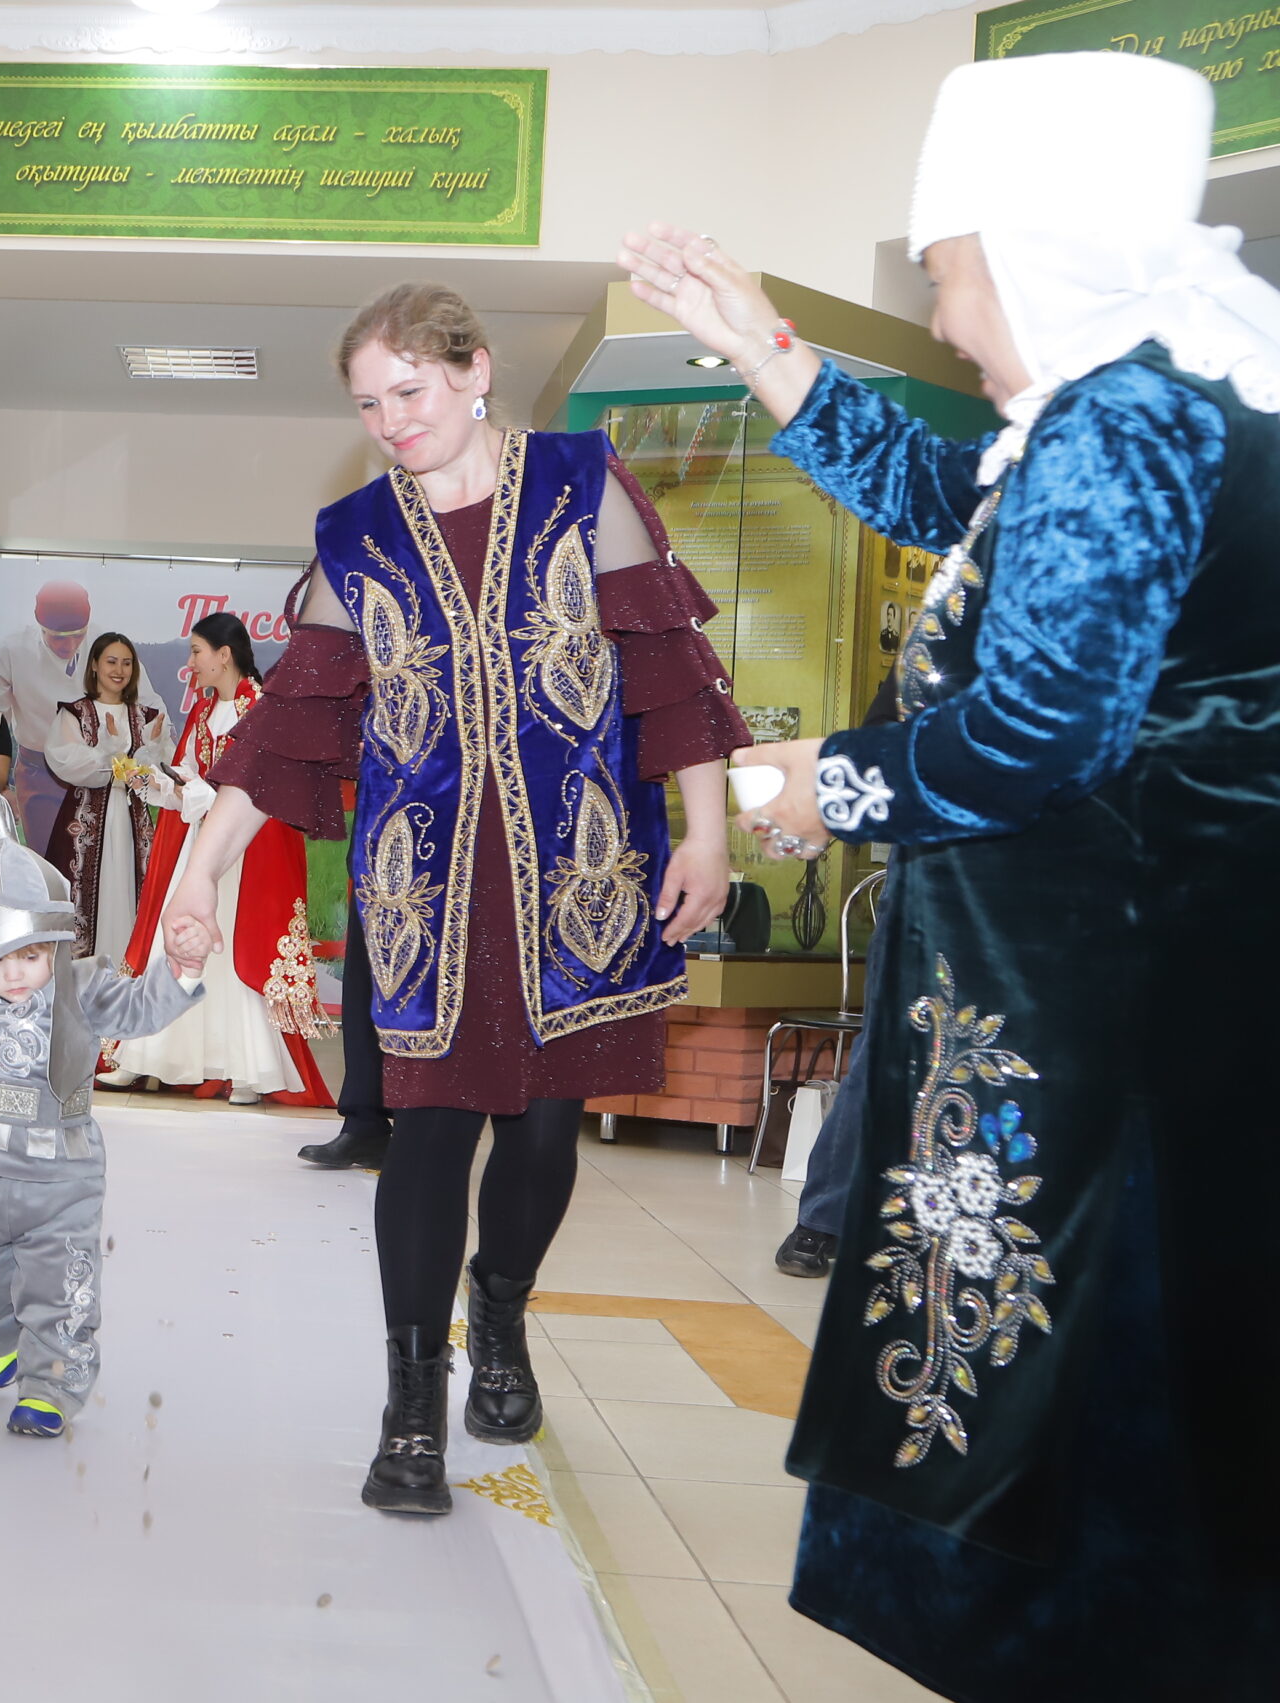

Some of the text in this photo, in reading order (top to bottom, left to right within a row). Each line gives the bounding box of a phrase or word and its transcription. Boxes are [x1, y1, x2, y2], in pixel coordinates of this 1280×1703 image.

[1195, 57, 1244, 82] еню
[78, 120, 107, 145] ең
[121, 113, 260, 144] қымбатты
[273, 124, 337, 152] адам
[381, 124, 463, 150] халық
[15, 163, 131, 192] оқытушы
[170, 164, 306, 192] мектептің
[320, 165, 417, 198] шешуші
[429, 167, 492, 198] күші
